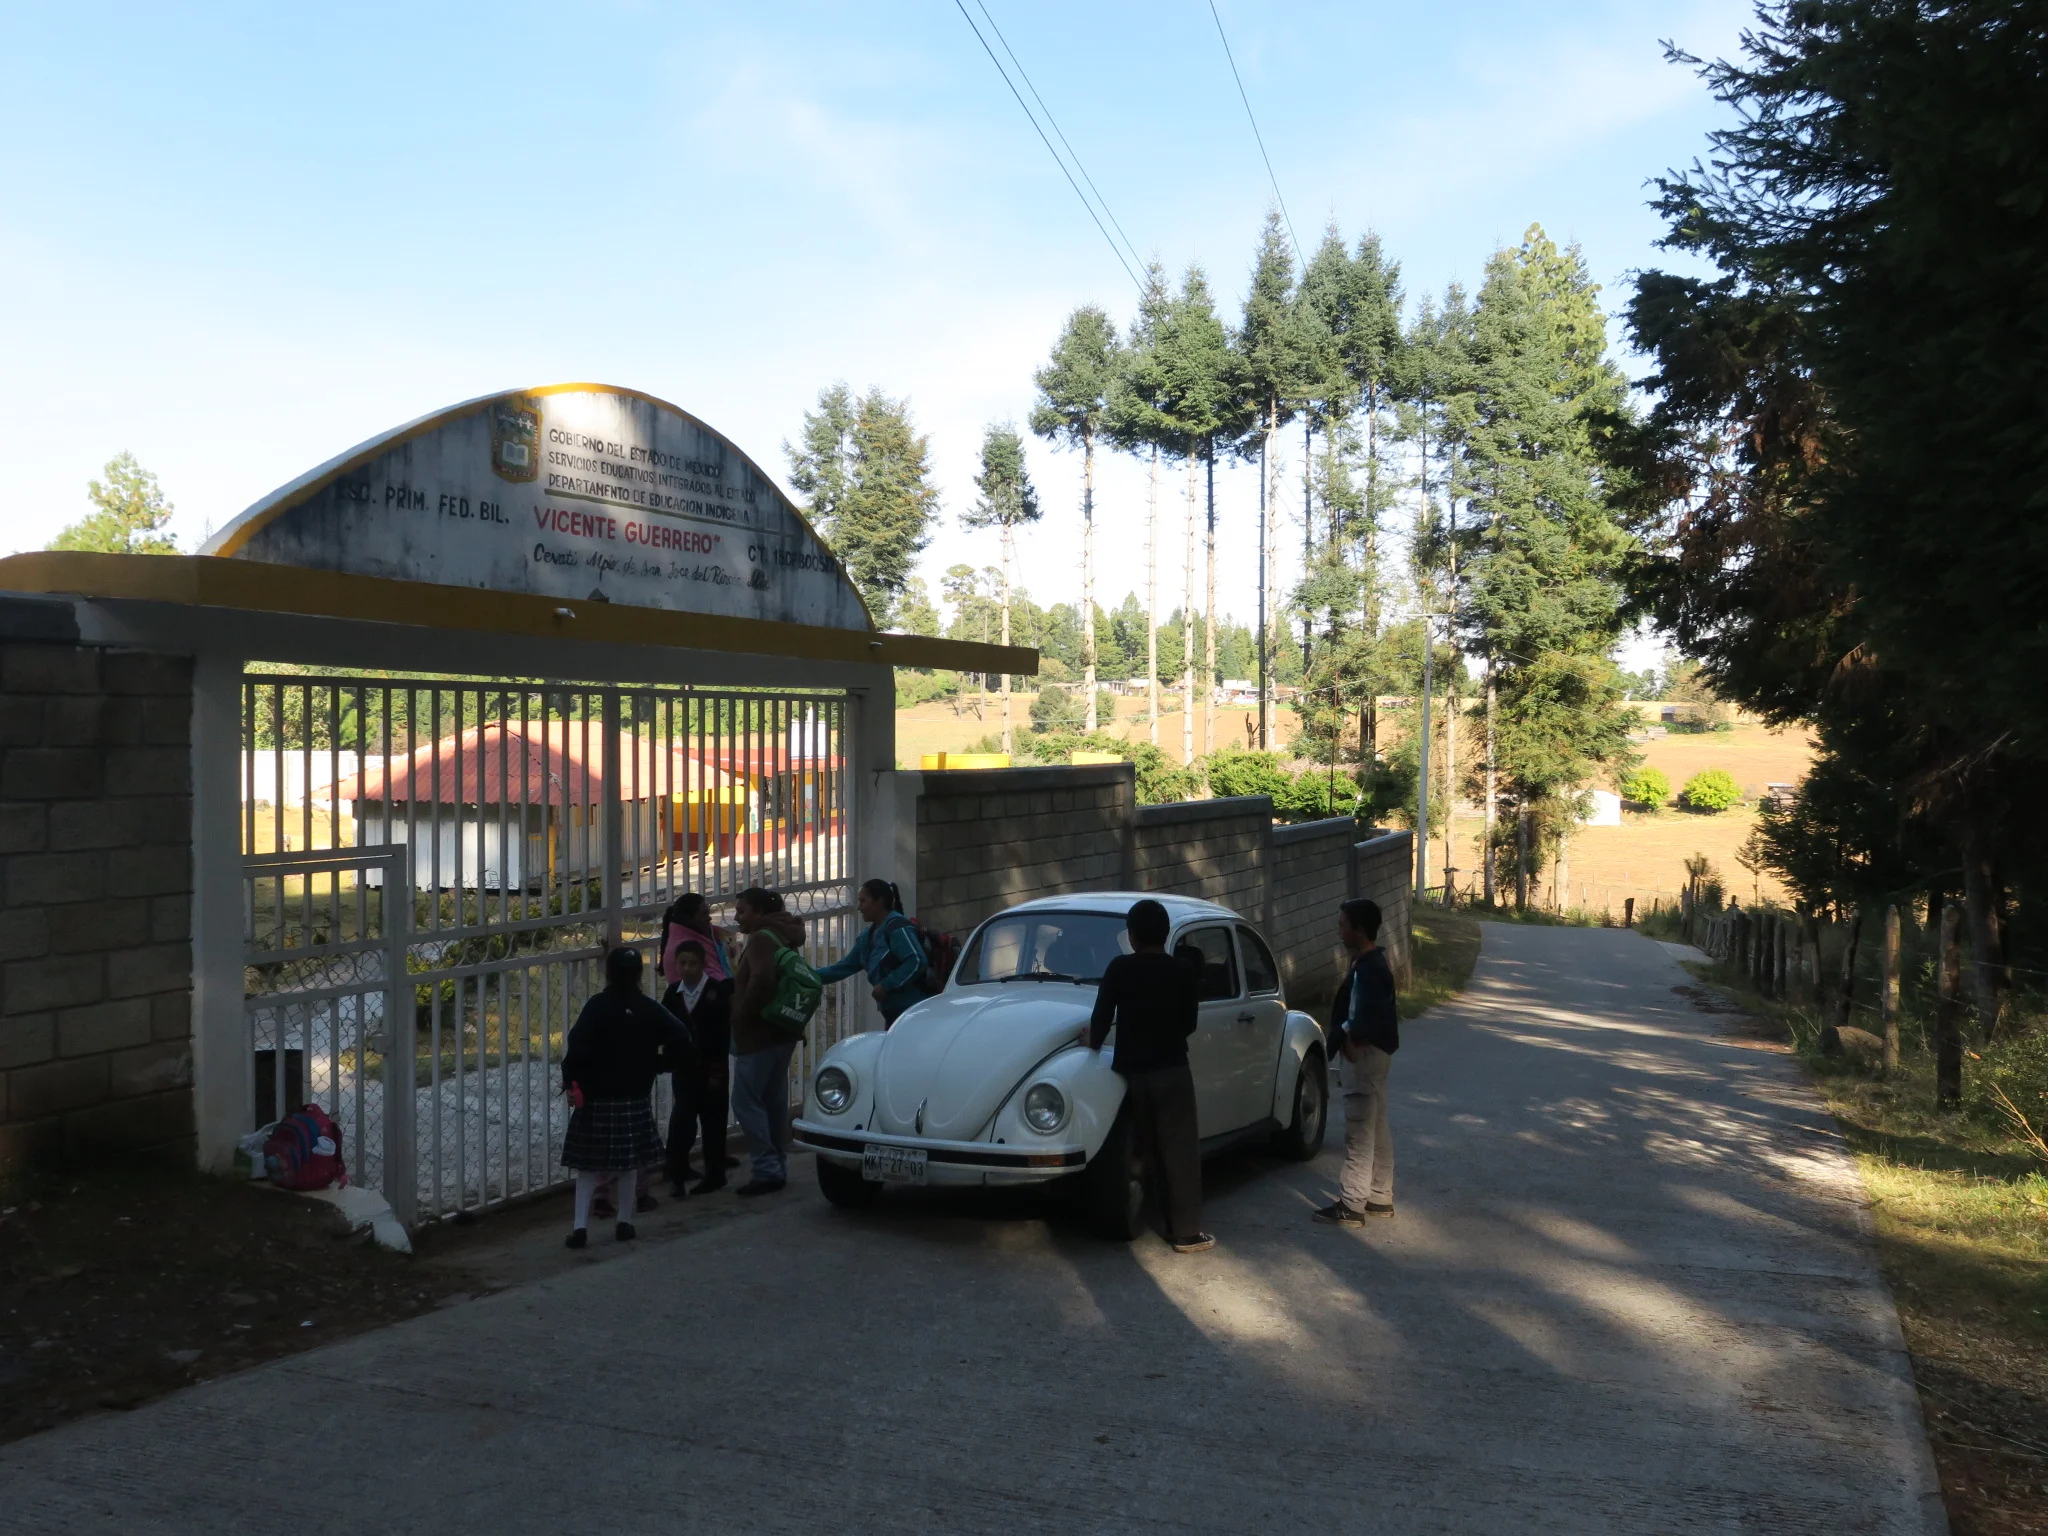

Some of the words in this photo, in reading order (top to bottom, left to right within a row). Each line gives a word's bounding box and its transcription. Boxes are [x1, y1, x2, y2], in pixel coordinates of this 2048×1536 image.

[549, 428, 604, 454] GOBIERNO
[607, 442, 625, 459] DEL
[630, 446, 667, 467] ESTADO
[669, 456, 680, 471] DE
[548, 451, 598, 473] SERVICIOS
[600, 461, 654, 483] EDUCATIVOS
[658, 473, 712, 496] INTEGRADOS
[714, 484, 724, 498] AL
[385, 486, 429, 512] PRIM.
[439, 494, 474, 519] FED.
[480, 501, 510, 524] BIL.
[549, 473, 630, 501] DEPARTAMENTO
[633, 489, 646, 504] DE
[649, 492, 702, 514] EDUCACION
[705, 502, 750, 524] INDIGEA
[533, 505, 617, 540] VICENTE
[692, 564, 708, 582] del
